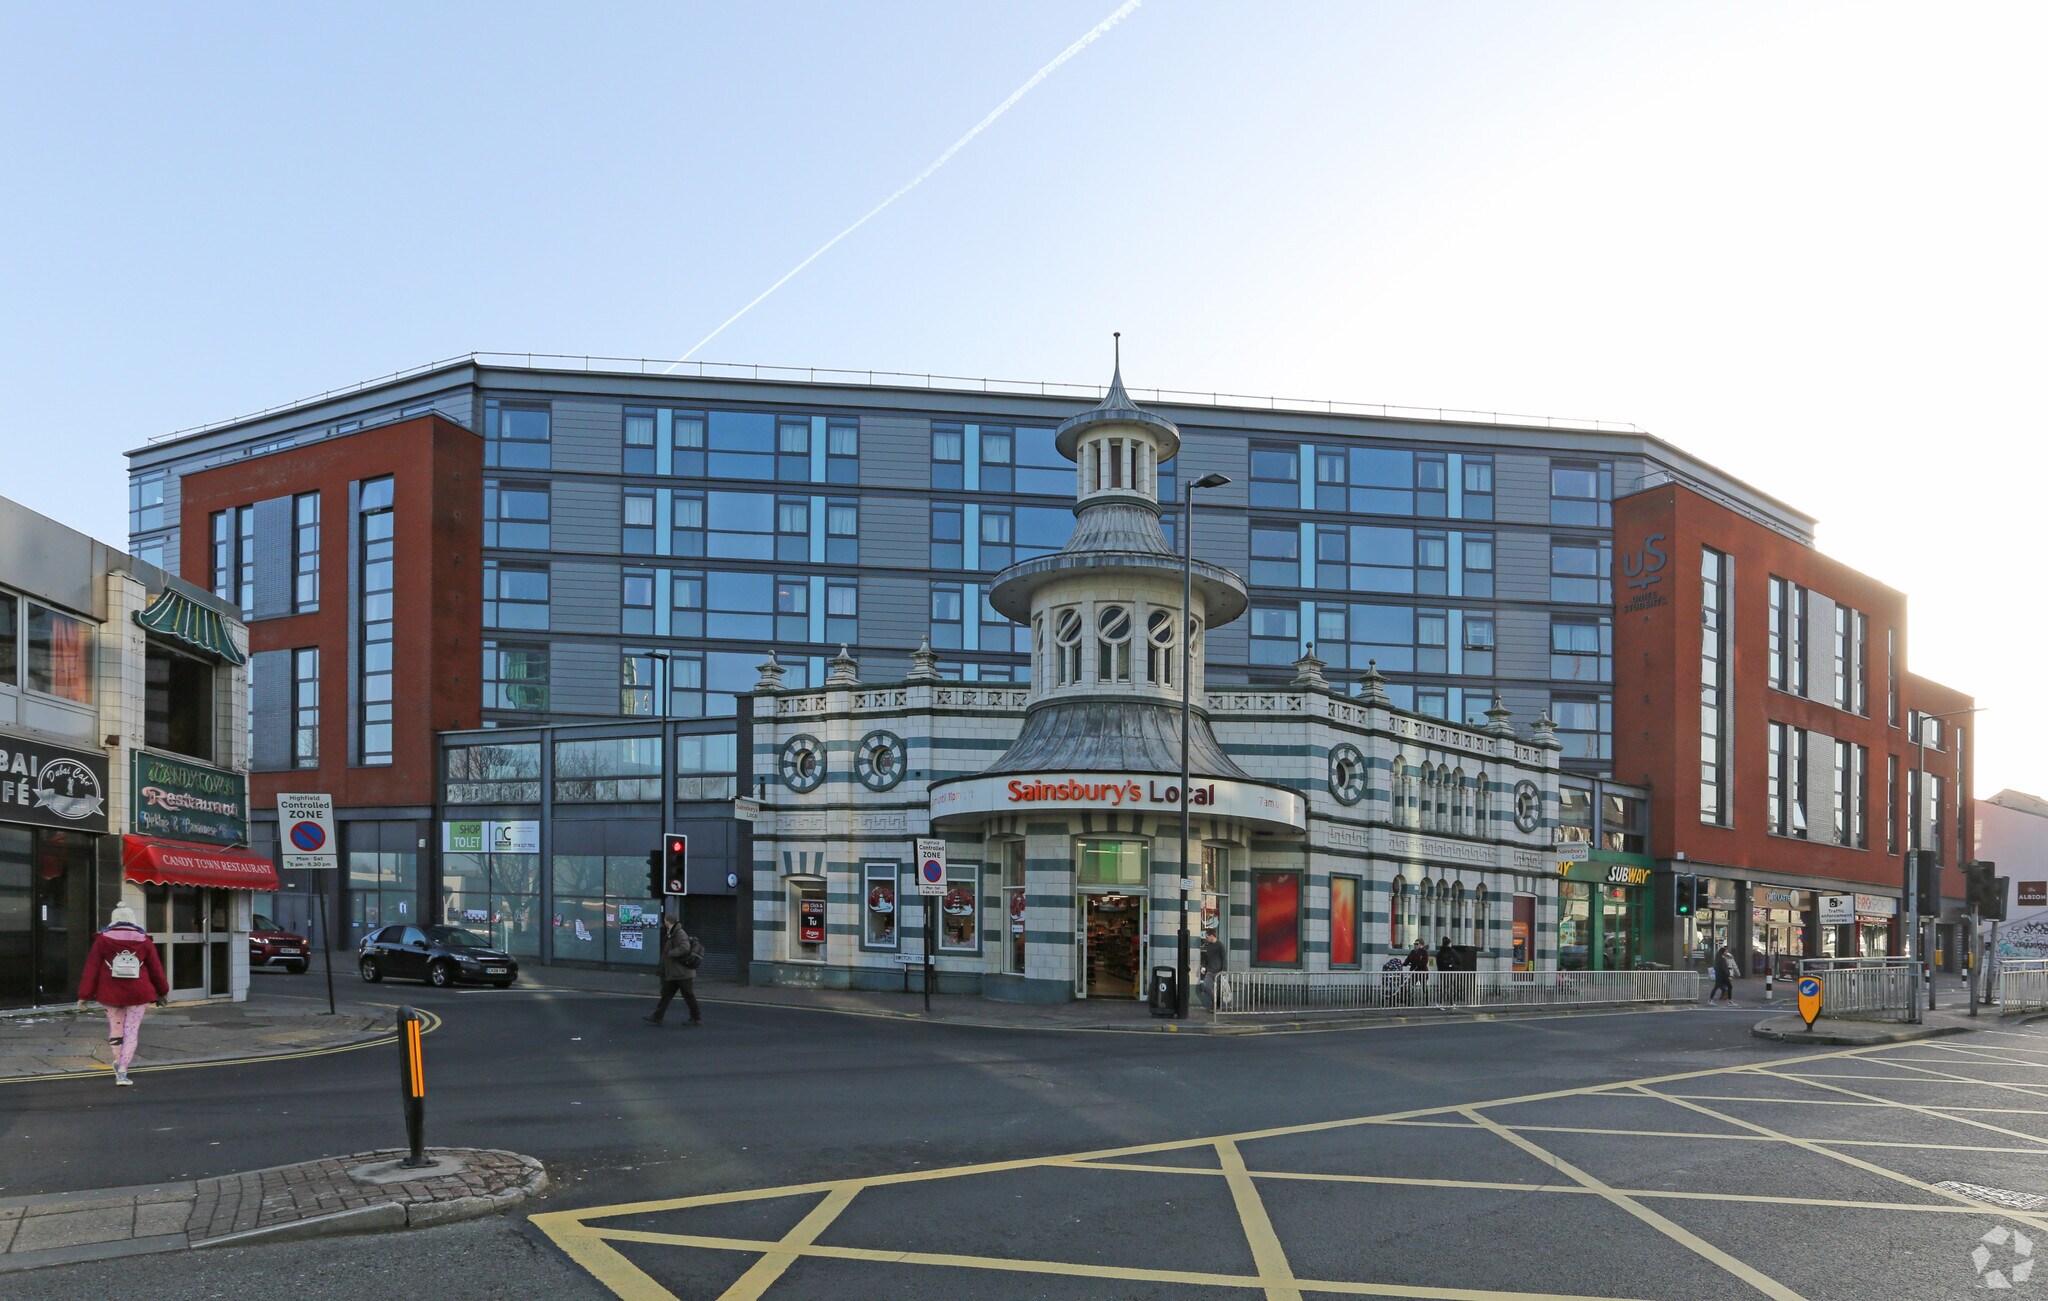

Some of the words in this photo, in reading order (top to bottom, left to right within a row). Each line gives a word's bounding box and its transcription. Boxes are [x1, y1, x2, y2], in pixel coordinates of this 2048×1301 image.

[1008, 778, 1142, 806] Sainsbury's
[281, 801, 330, 809] Controlled
[289, 810, 324, 819] ZONE
[459, 824, 481, 835] SHOP
[454, 836, 466, 848] TO
[466, 837, 481, 848] LET
[923, 851, 941, 859] ZONE
[162, 854, 195, 868] CANDY
[194, 858, 221, 870] TOWN
[221, 860, 272, 874] RESTAURANT
[1608, 865, 1651, 884] SUBWAY
[808, 916, 817, 926] Tu
